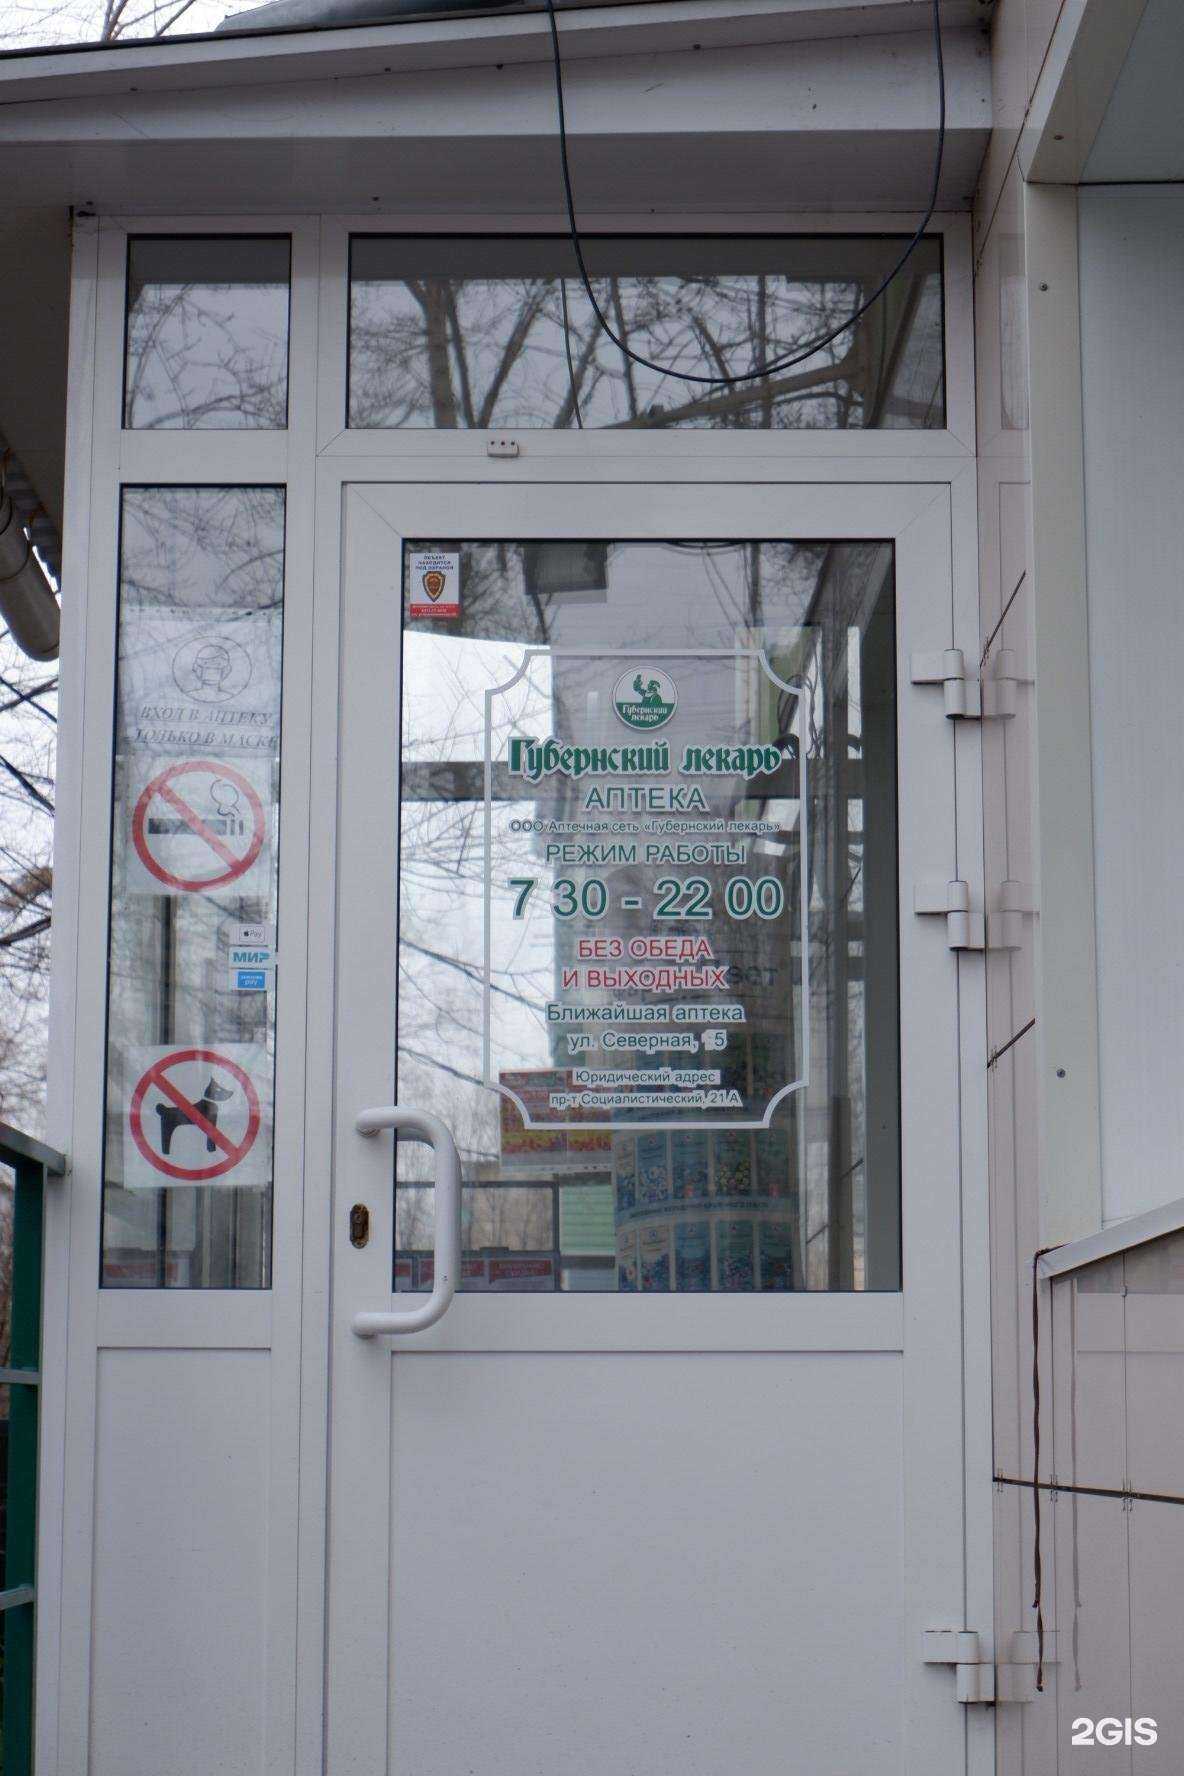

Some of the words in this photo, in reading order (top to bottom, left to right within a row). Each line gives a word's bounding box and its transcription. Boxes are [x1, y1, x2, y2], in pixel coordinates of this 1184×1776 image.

[622, 704, 668, 716] Губернский
[134, 727, 201, 746] ТОЛЬКО
[204, 732, 217, 745] В
[510, 738, 670, 781] Губернский
[681, 745, 781, 777] лекарь
[585, 786, 706, 810] АПТЕКА
[510, 820, 543, 832] ООО
[548, 820, 608, 832] Аптечная
[612, 823, 640, 832] сеть
[644, 820, 724, 836] «Губернский
[729, 822, 780, 835] лекарь»
[546, 844, 636, 862] РЕЖИМ
[646, 844, 746, 862] РАБОТЫ
[232, 951, 270, 963] МИР
[579, 939, 622, 959] БЕЗ
[630, 938, 712, 962] ОБЕДА
[562, 969, 580, 989] И
[587, 968, 727, 992] ВЫХОДНЫХ
[547, 1002, 668, 1021] Ближайшая
[674, 1006, 743, 1021] аптека
[569, 1035, 595, 1050] ул.
[602, 1032, 698, 1050] Северная,
[575, 1070, 670, 1085] Юридический
[675, 1072, 716, 1085] адрес
[551, 1096, 577, 1107] пр-т
